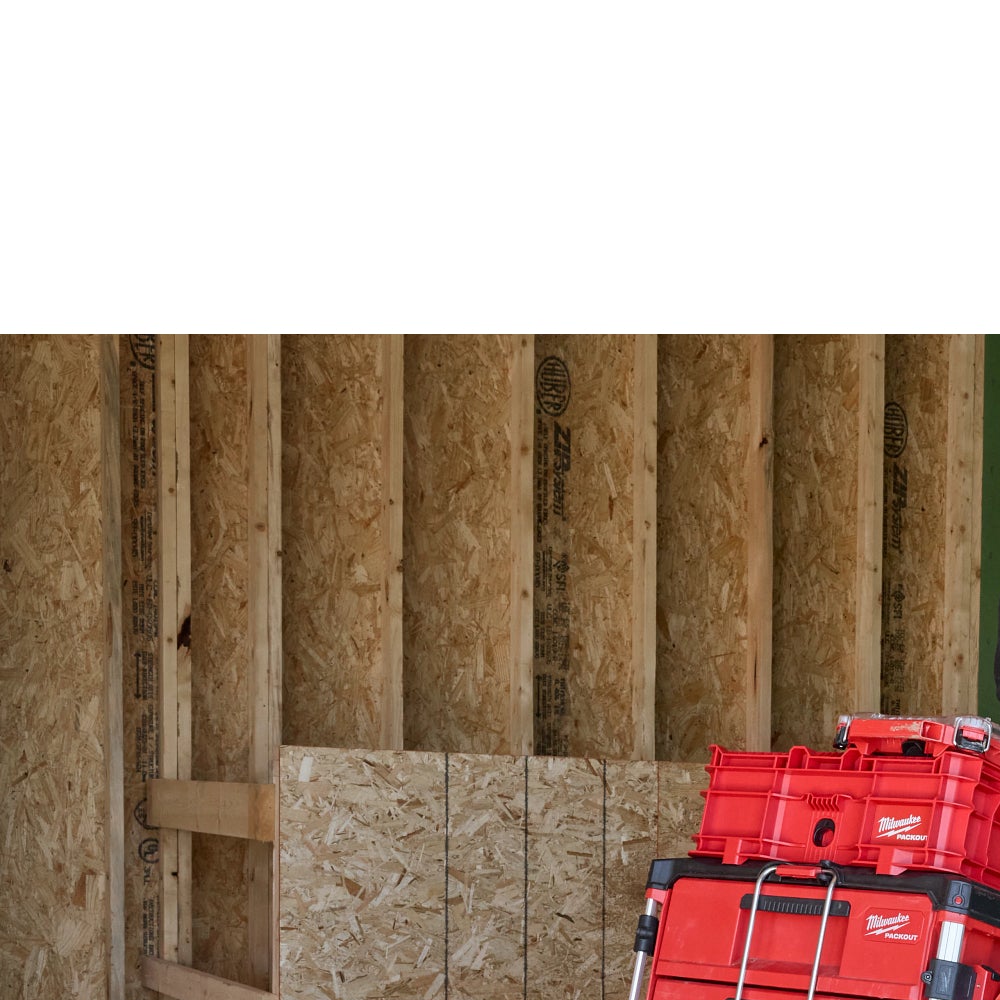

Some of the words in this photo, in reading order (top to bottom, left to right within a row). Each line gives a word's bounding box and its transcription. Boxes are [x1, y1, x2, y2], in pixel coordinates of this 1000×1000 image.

[541, 361, 568, 412] HUBER
[877, 814, 921, 833] Milwaukee
[896, 833, 929, 842] PACKOUT
[866, 913, 910, 932] Milwaukee
[884, 932, 919, 942] PACKOUT
